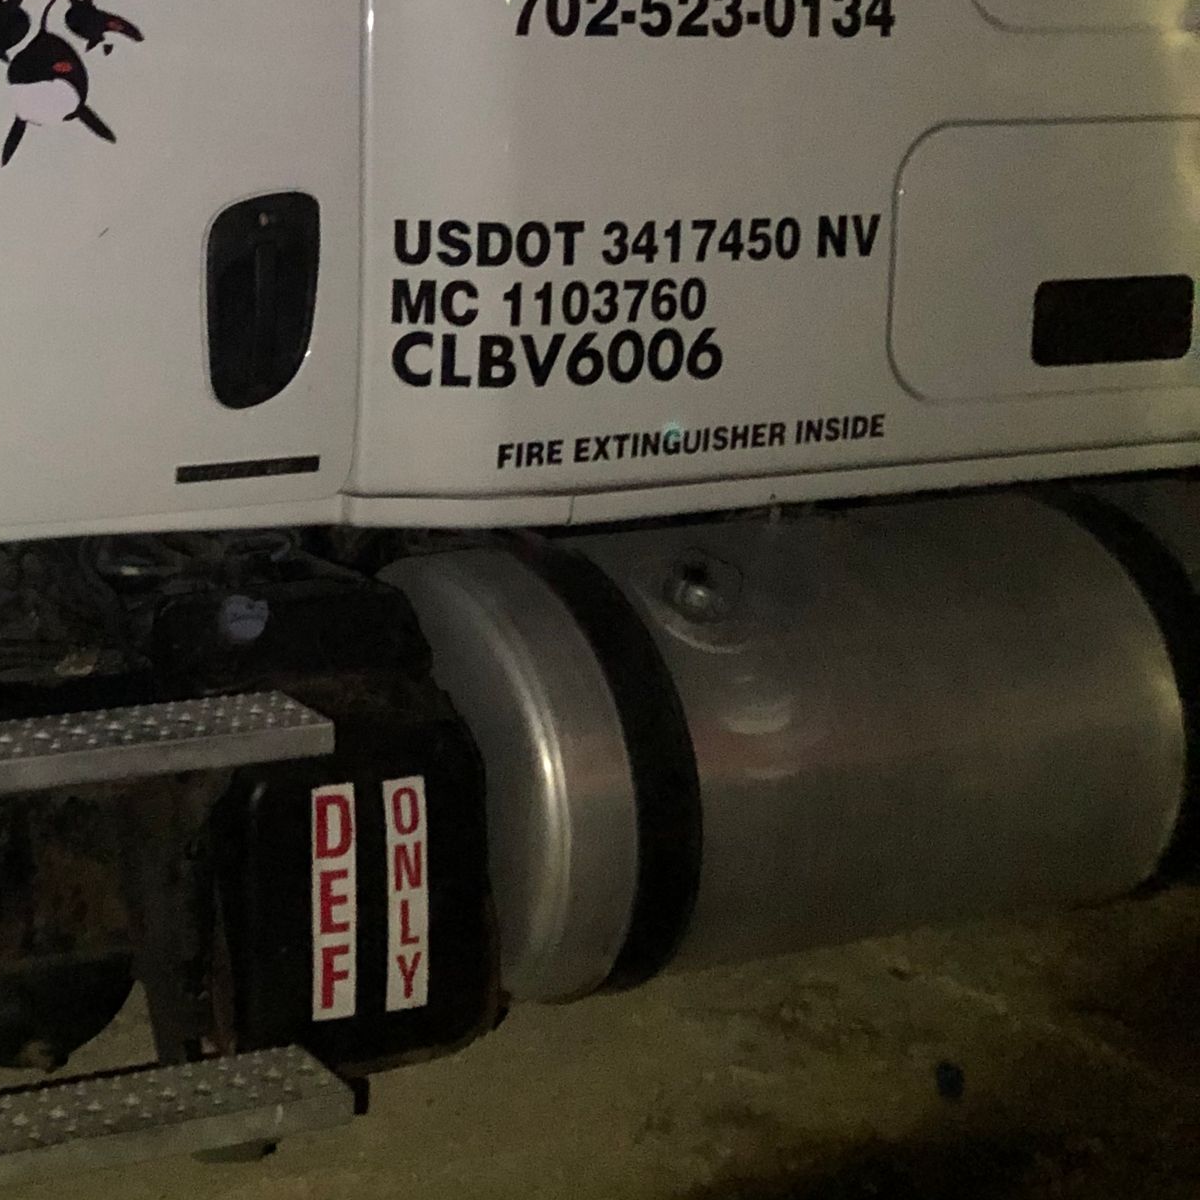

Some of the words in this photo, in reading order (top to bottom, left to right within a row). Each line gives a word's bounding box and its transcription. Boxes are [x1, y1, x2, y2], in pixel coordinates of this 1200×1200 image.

[394, 219, 586, 267] USDOT
[602, 216, 802, 266] 3417450
[816, 213, 883, 259] NV
[391, 278, 480, 327] MC
[503, 277, 708, 327] 1103760
[391, 327, 724, 388] CLBV6006
[497, 440, 563, 469] FIRE
[574, 422, 787, 463] EXTINGUISHER
[795, 413, 886, 445] INSIDE
[314, 794, 352, 1010] DEF
[391, 786, 423, 999] ONLY
